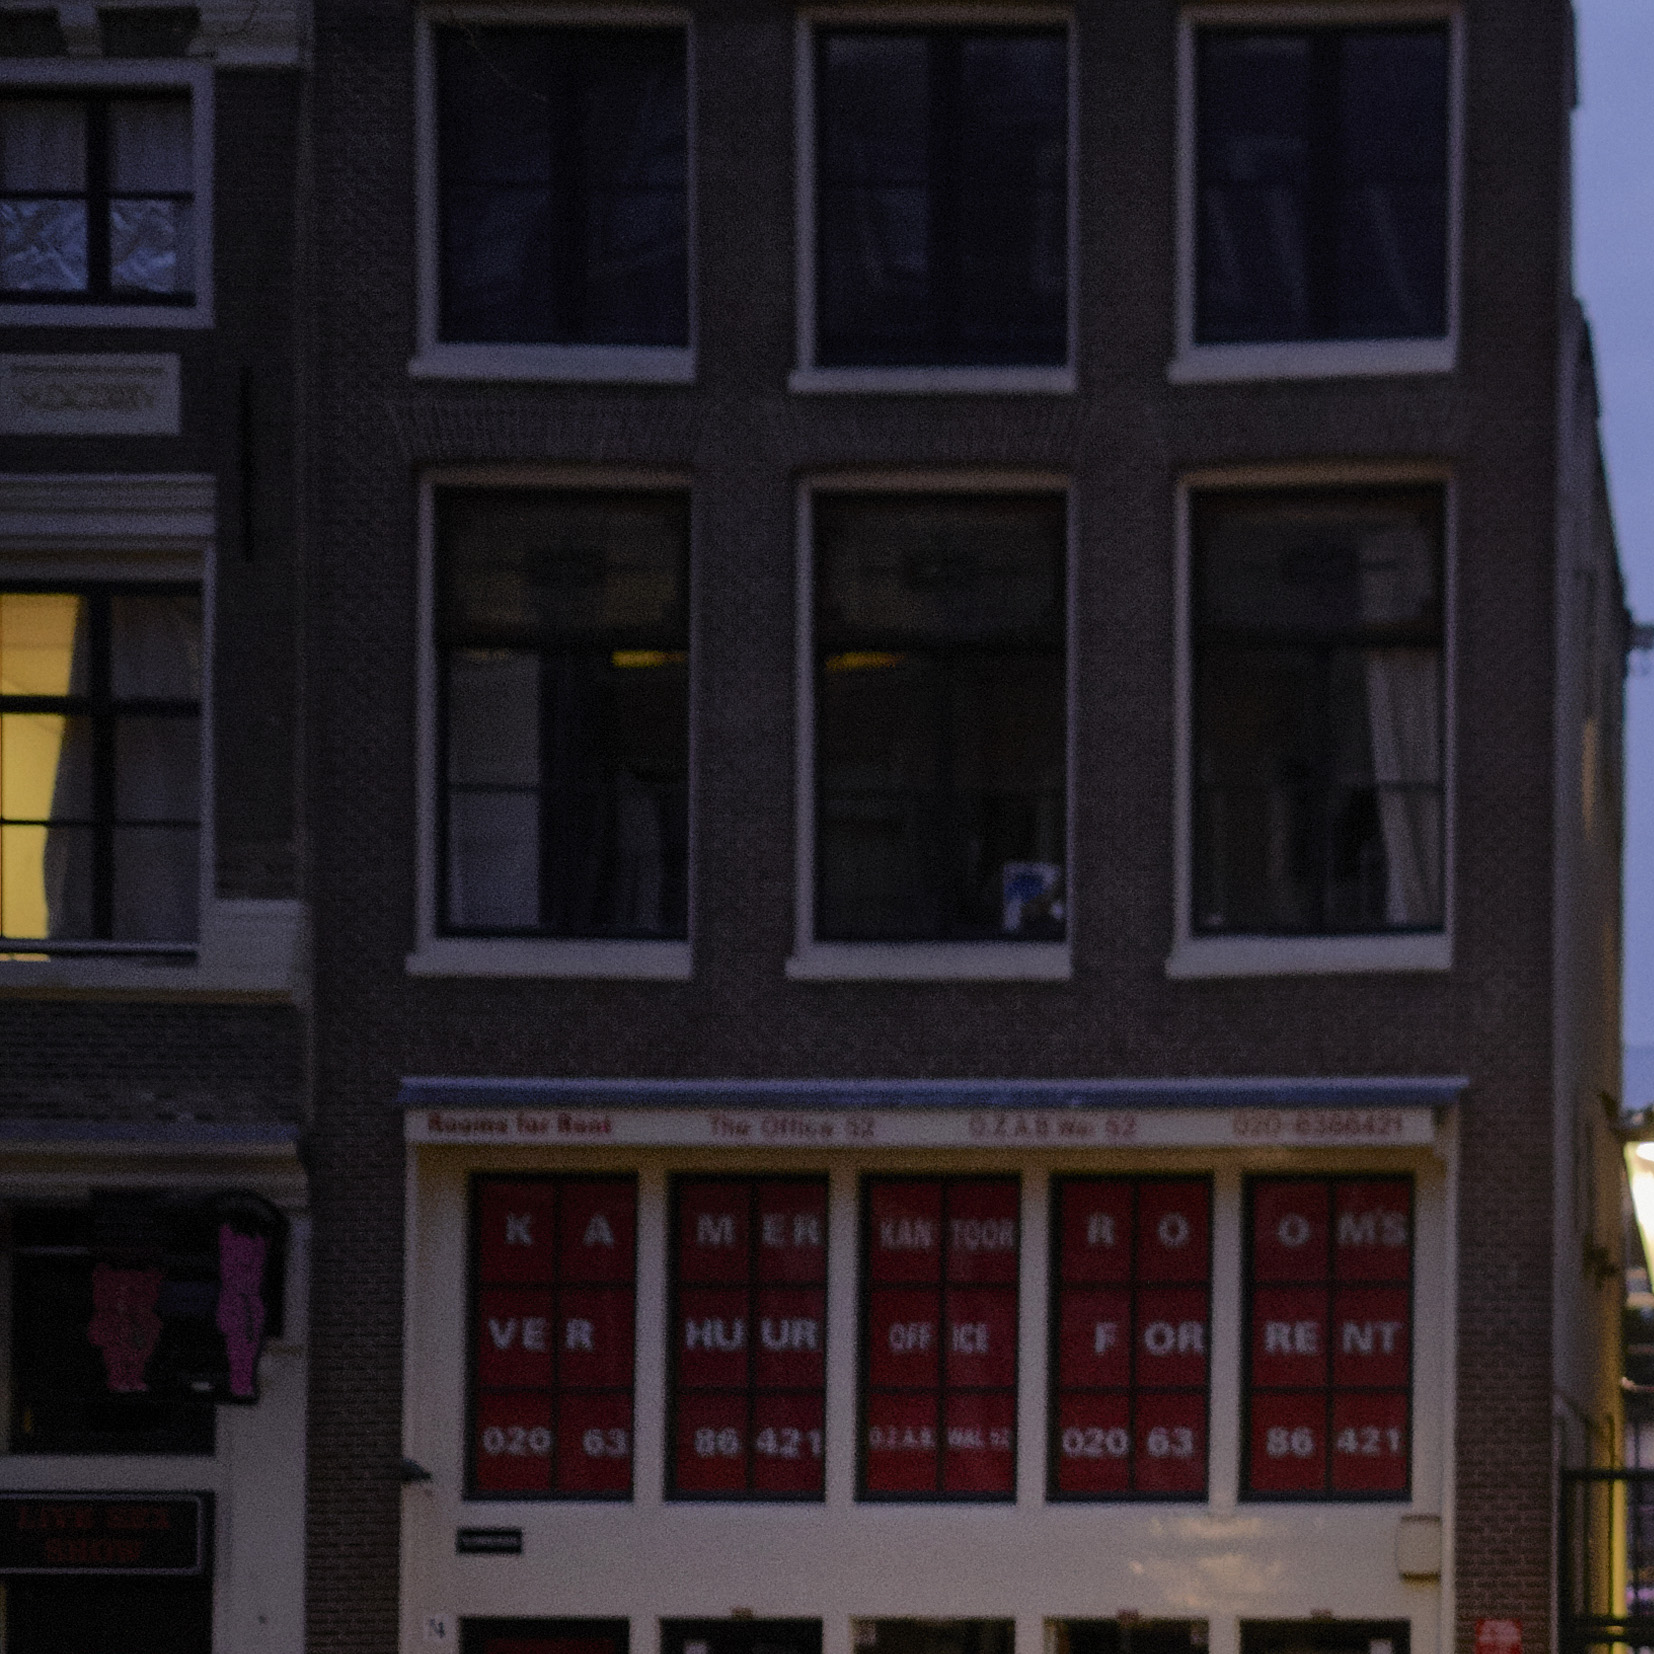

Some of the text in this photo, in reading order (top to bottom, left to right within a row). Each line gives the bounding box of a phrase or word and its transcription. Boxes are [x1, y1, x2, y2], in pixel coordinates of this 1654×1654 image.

[482, 1425, 630, 1459] 020 63
[694, 1425, 823, 1459] 86 421
[1061, 1426, 1194, 1459] 020 63
[1266, 1425, 1402, 1460] 86 421
